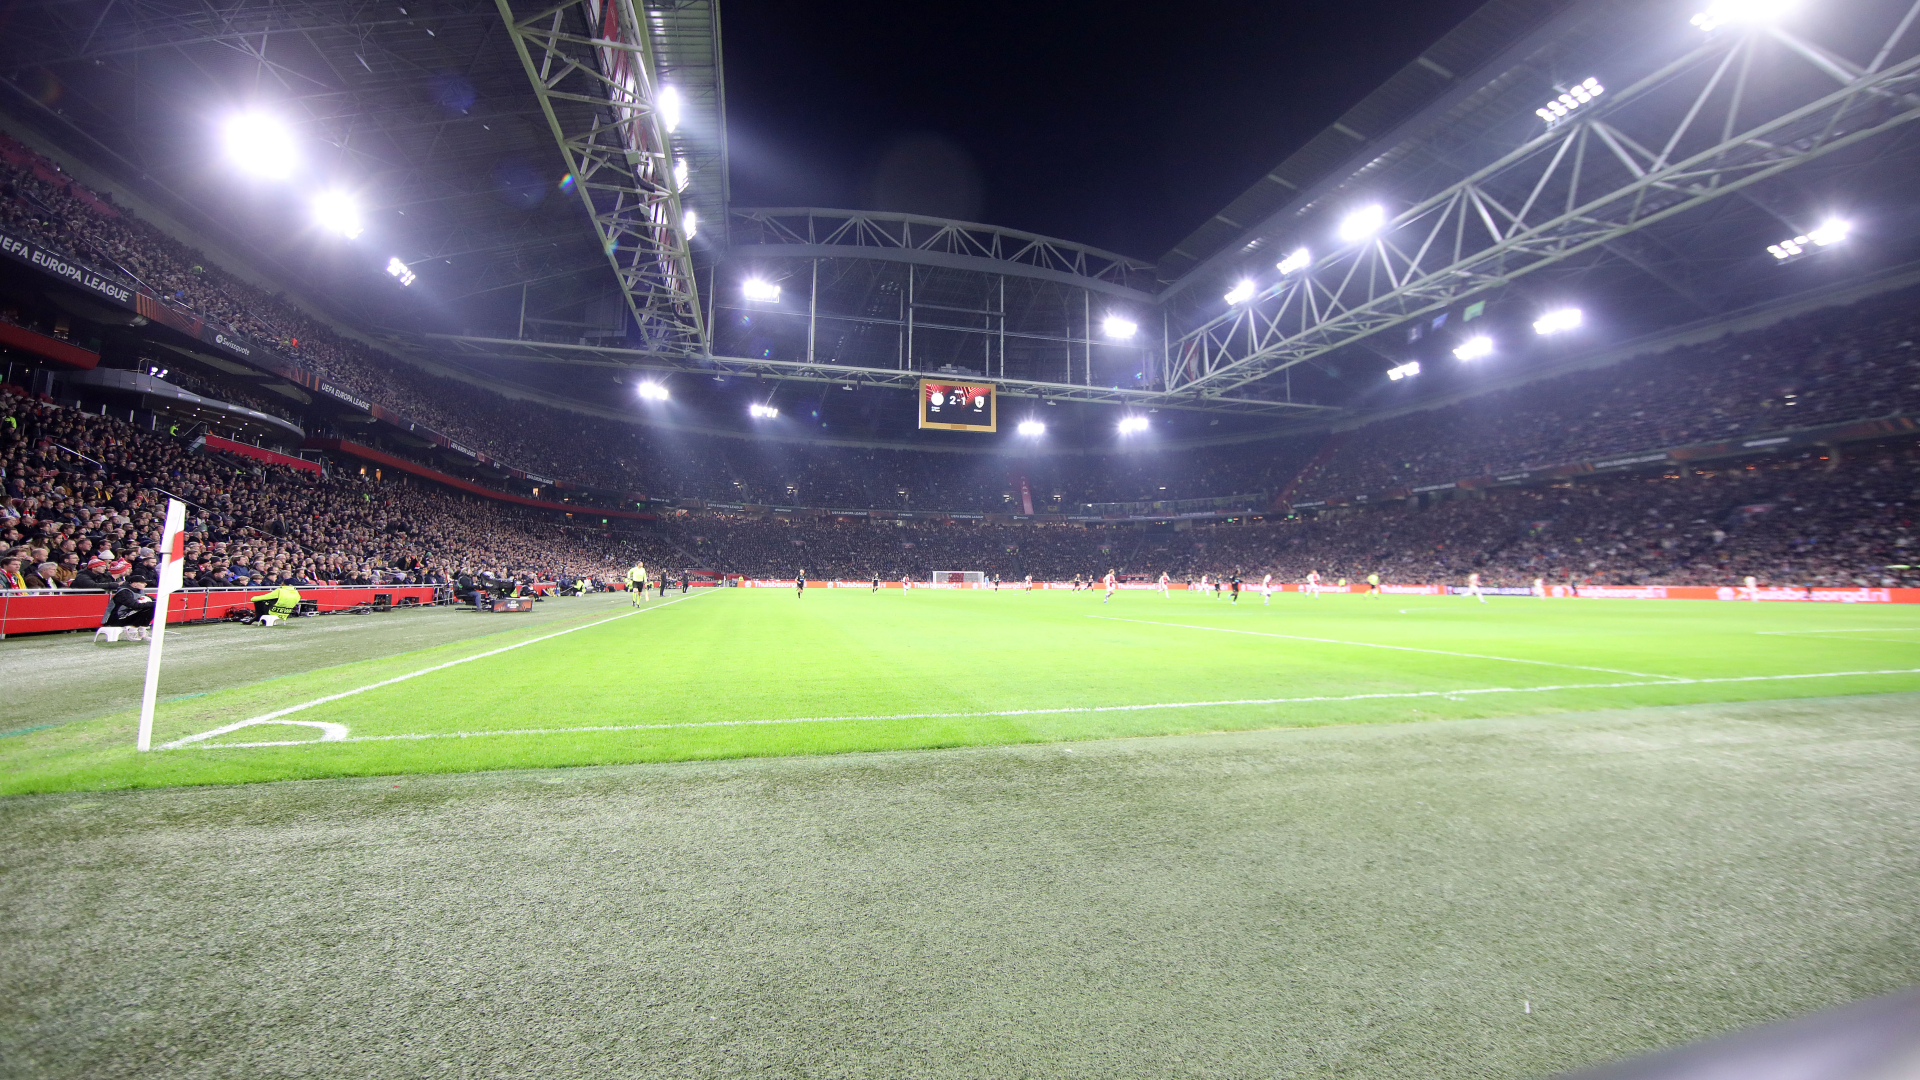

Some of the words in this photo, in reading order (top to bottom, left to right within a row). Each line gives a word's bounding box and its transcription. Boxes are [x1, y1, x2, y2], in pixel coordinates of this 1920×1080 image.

[32, 251, 82, 282] EUROPA
[84, 274, 130, 302] LEAGUE
[222, 337, 249, 355] Swissquote
[321, 383, 335, 395] UEFA
[335, 389, 353, 403] EUROPA
[353, 398, 370, 410] LEAGUE
